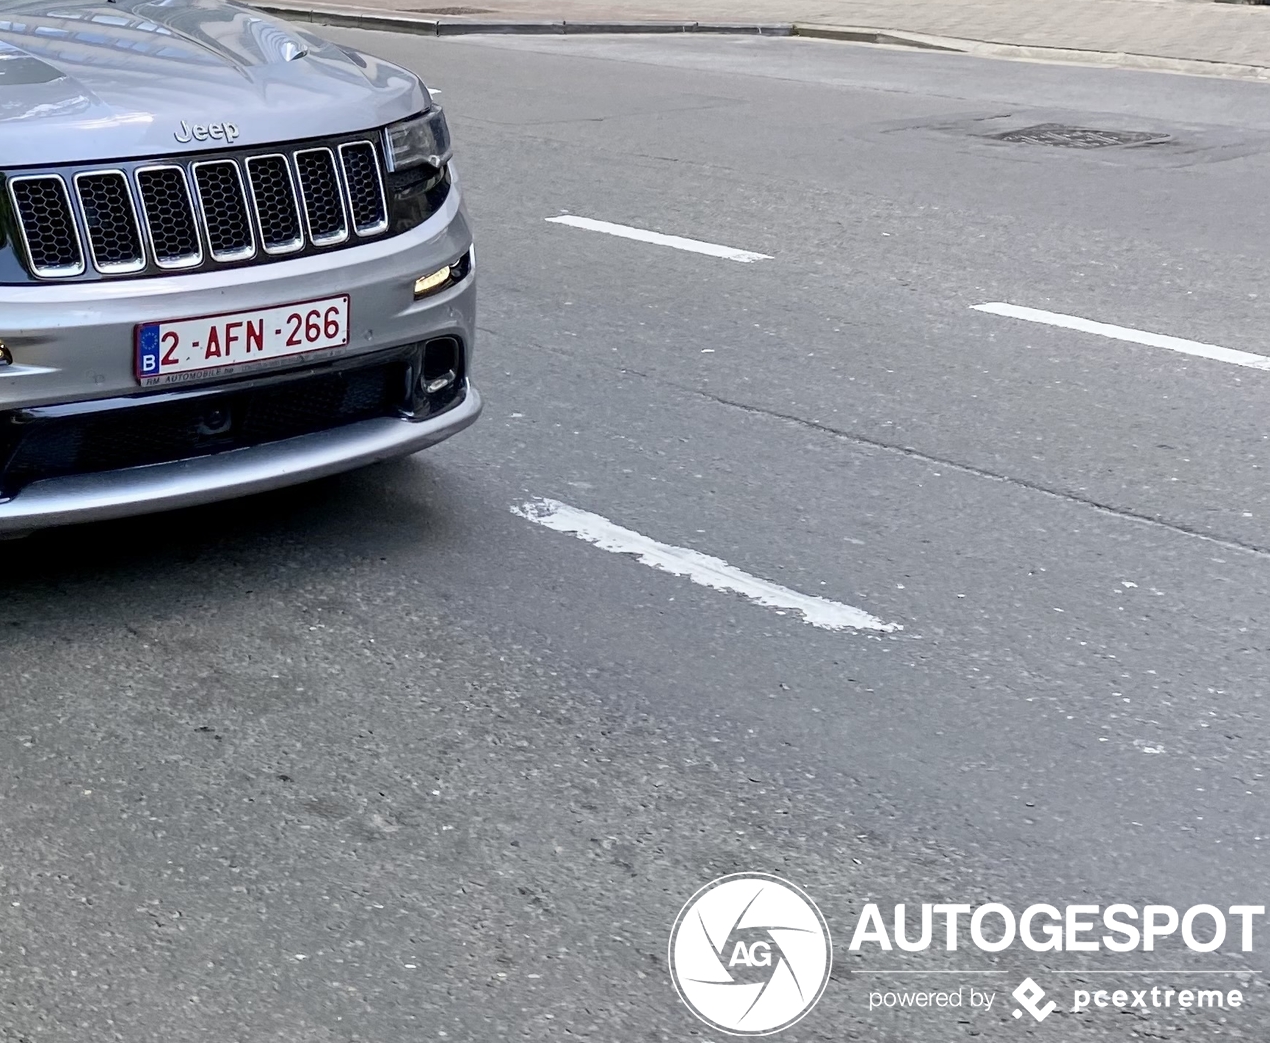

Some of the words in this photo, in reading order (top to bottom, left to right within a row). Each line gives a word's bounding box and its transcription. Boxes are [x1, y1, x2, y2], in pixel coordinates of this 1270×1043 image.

[174, 120, 239, 143] Jeep
[143, 354, 155, 371] B
[165, 369, 222, 383] AUTOMOBILE
